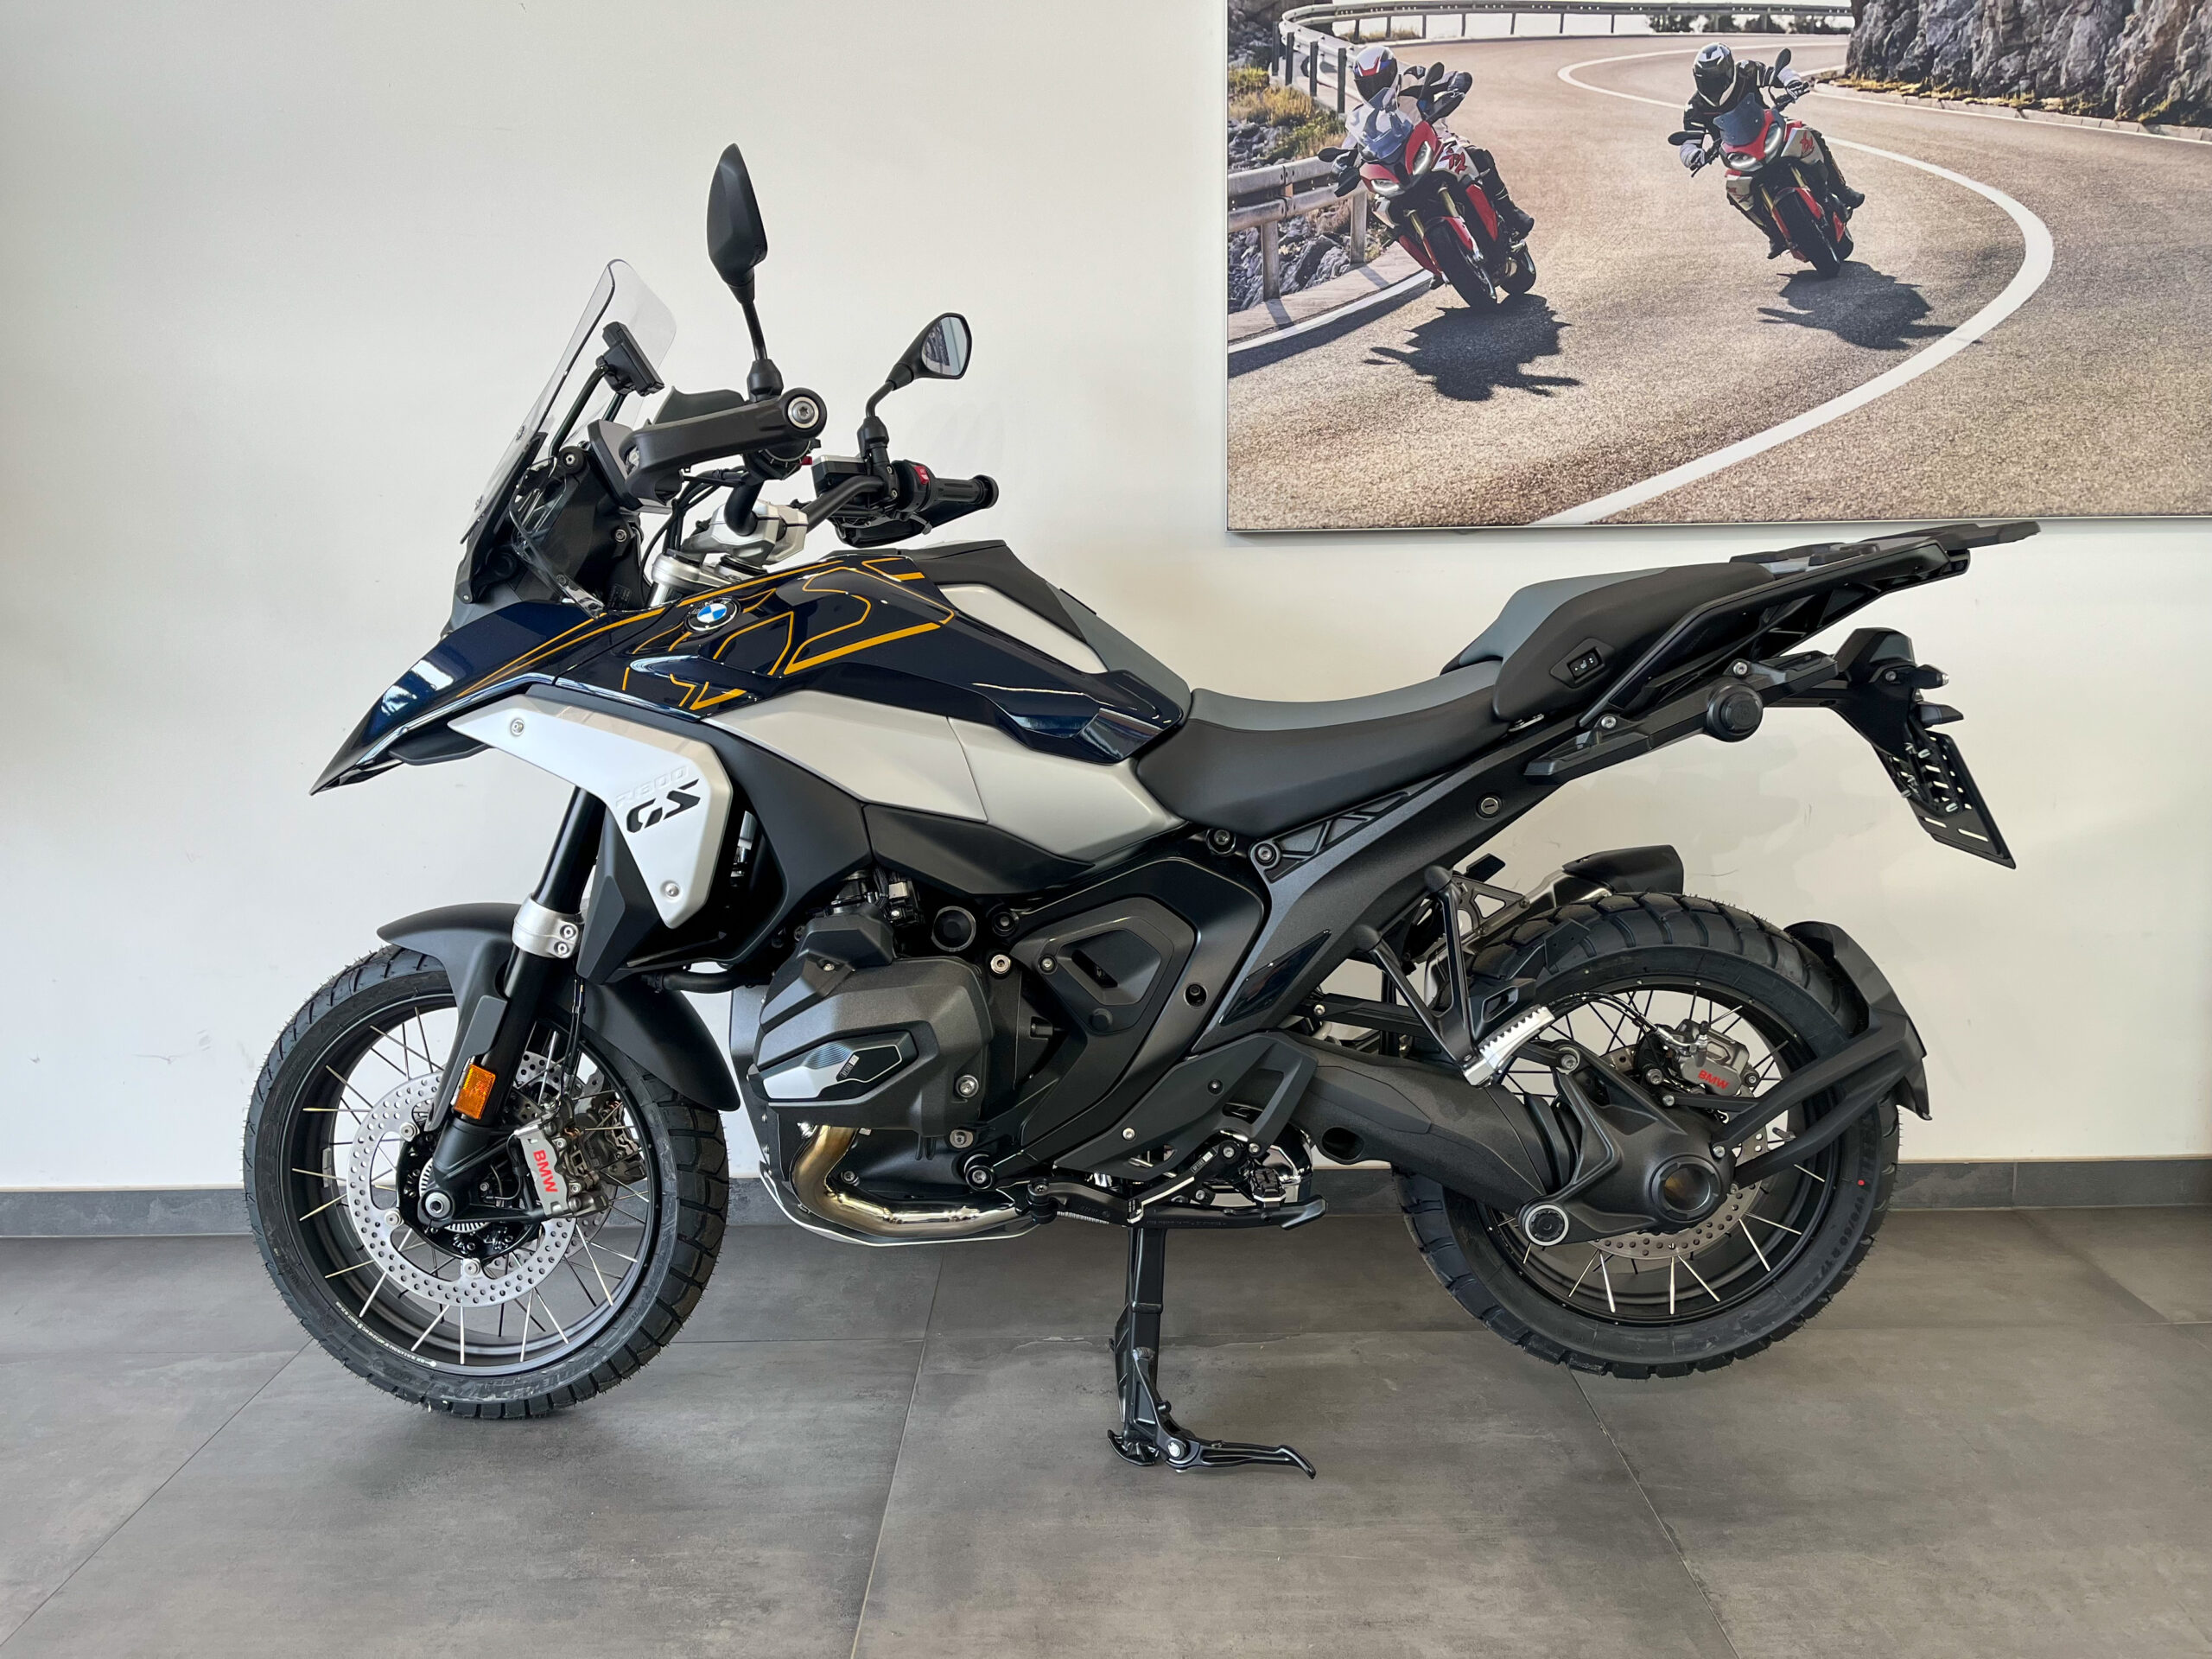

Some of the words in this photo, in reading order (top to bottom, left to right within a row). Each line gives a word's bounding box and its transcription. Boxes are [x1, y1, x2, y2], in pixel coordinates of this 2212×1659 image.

[626, 779, 701, 833] GS
[1698, 1070, 1729, 1089] BMW
[533, 1149, 558, 1192] BMW
